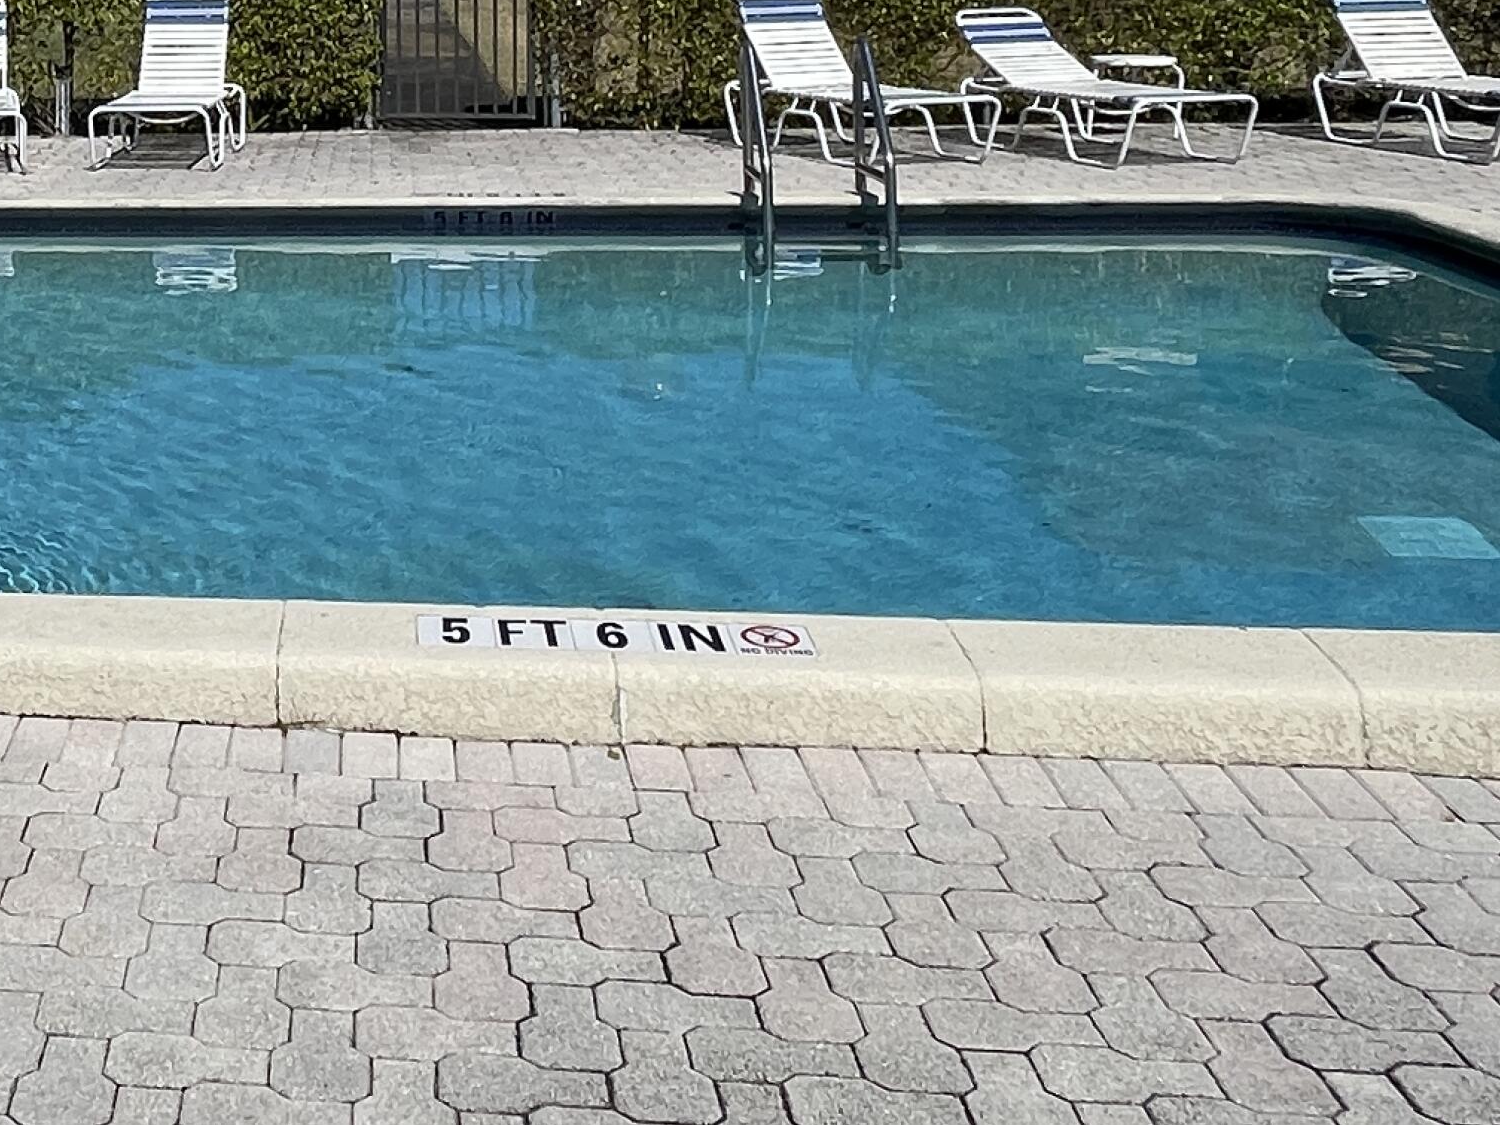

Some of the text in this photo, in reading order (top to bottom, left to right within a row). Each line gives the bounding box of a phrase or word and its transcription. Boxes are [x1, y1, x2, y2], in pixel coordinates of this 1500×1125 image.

[441, 617, 727, 652] 5 FT 6 IN
[740, 647, 814, 656] NO DIVING
